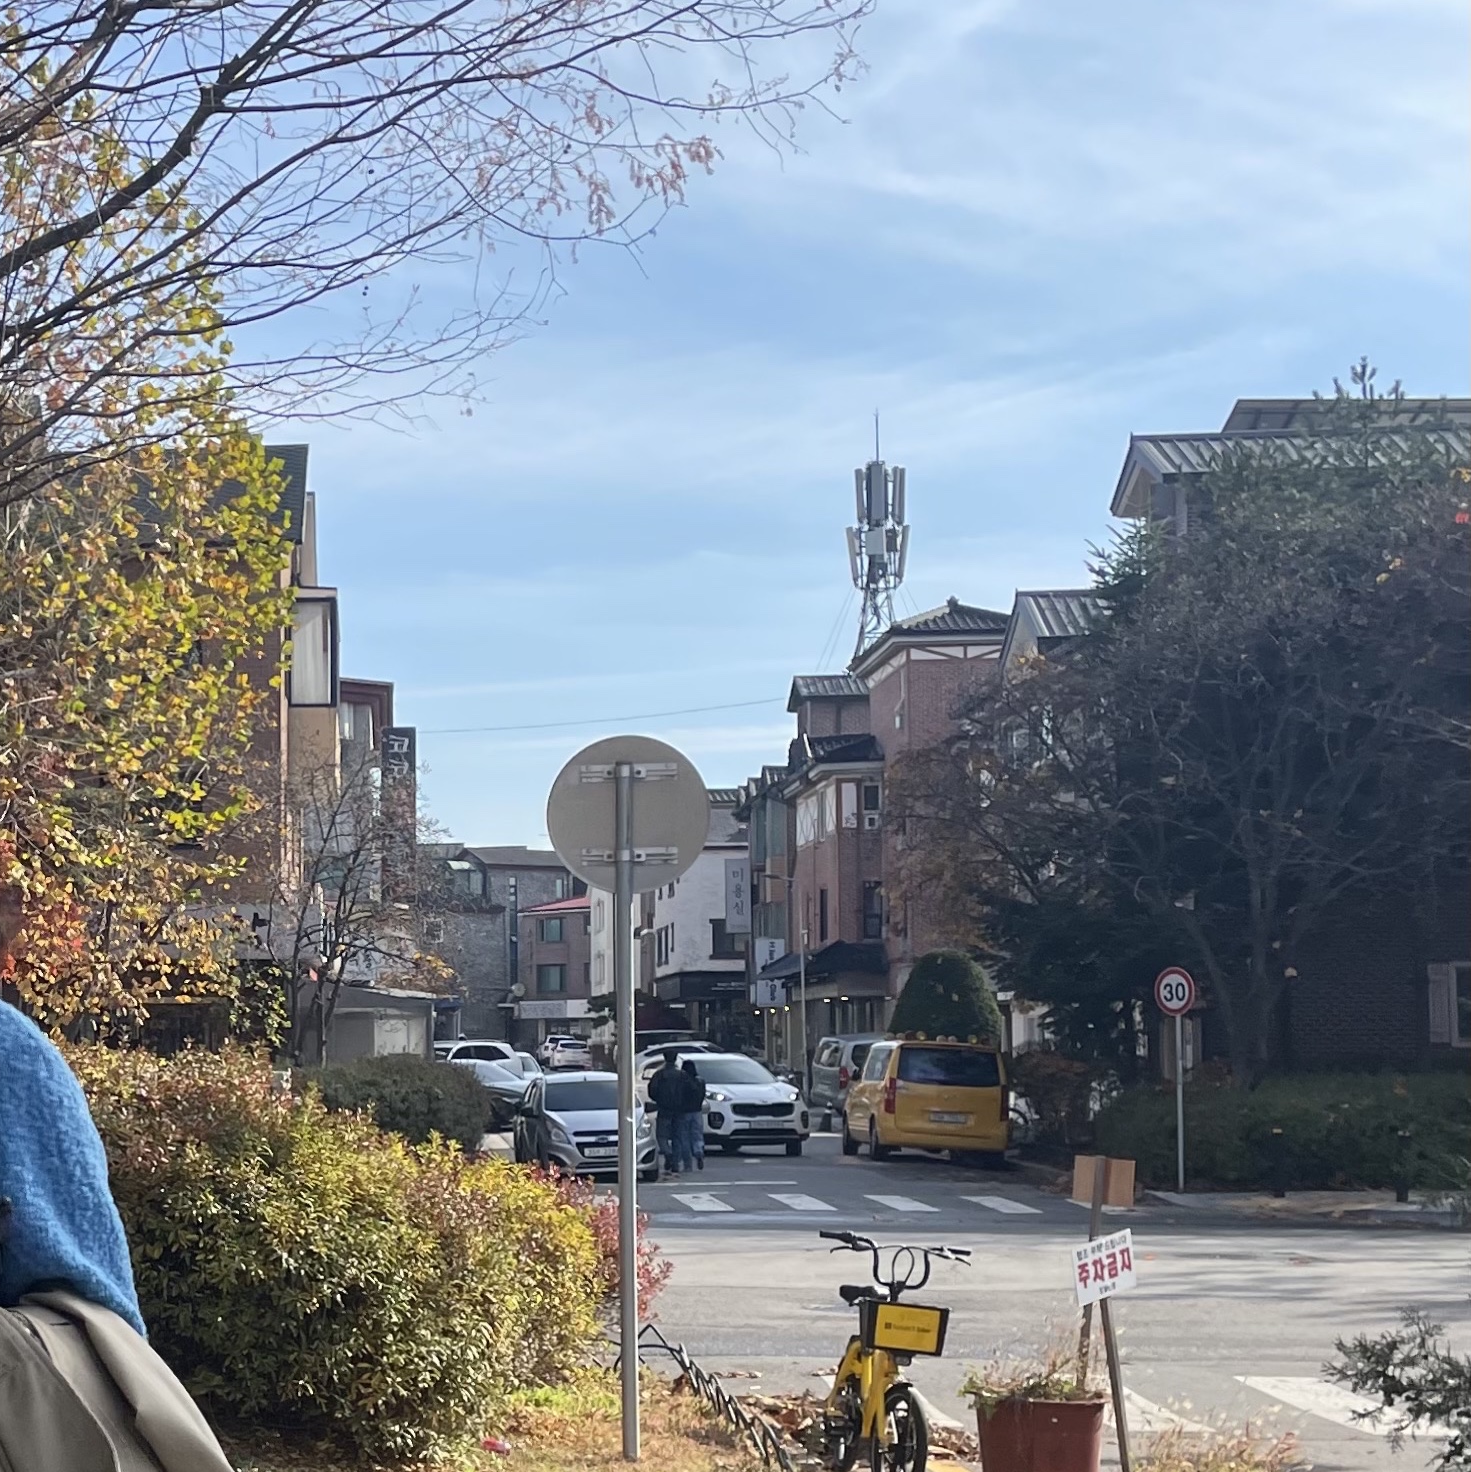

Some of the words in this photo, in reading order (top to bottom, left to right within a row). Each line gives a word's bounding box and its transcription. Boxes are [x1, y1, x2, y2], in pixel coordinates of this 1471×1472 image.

[732, 867, 744, 916] 미용실
[1163, 982, 1186, 1002] 30
[1077, 1246, 1132, 1289] 주차금지
